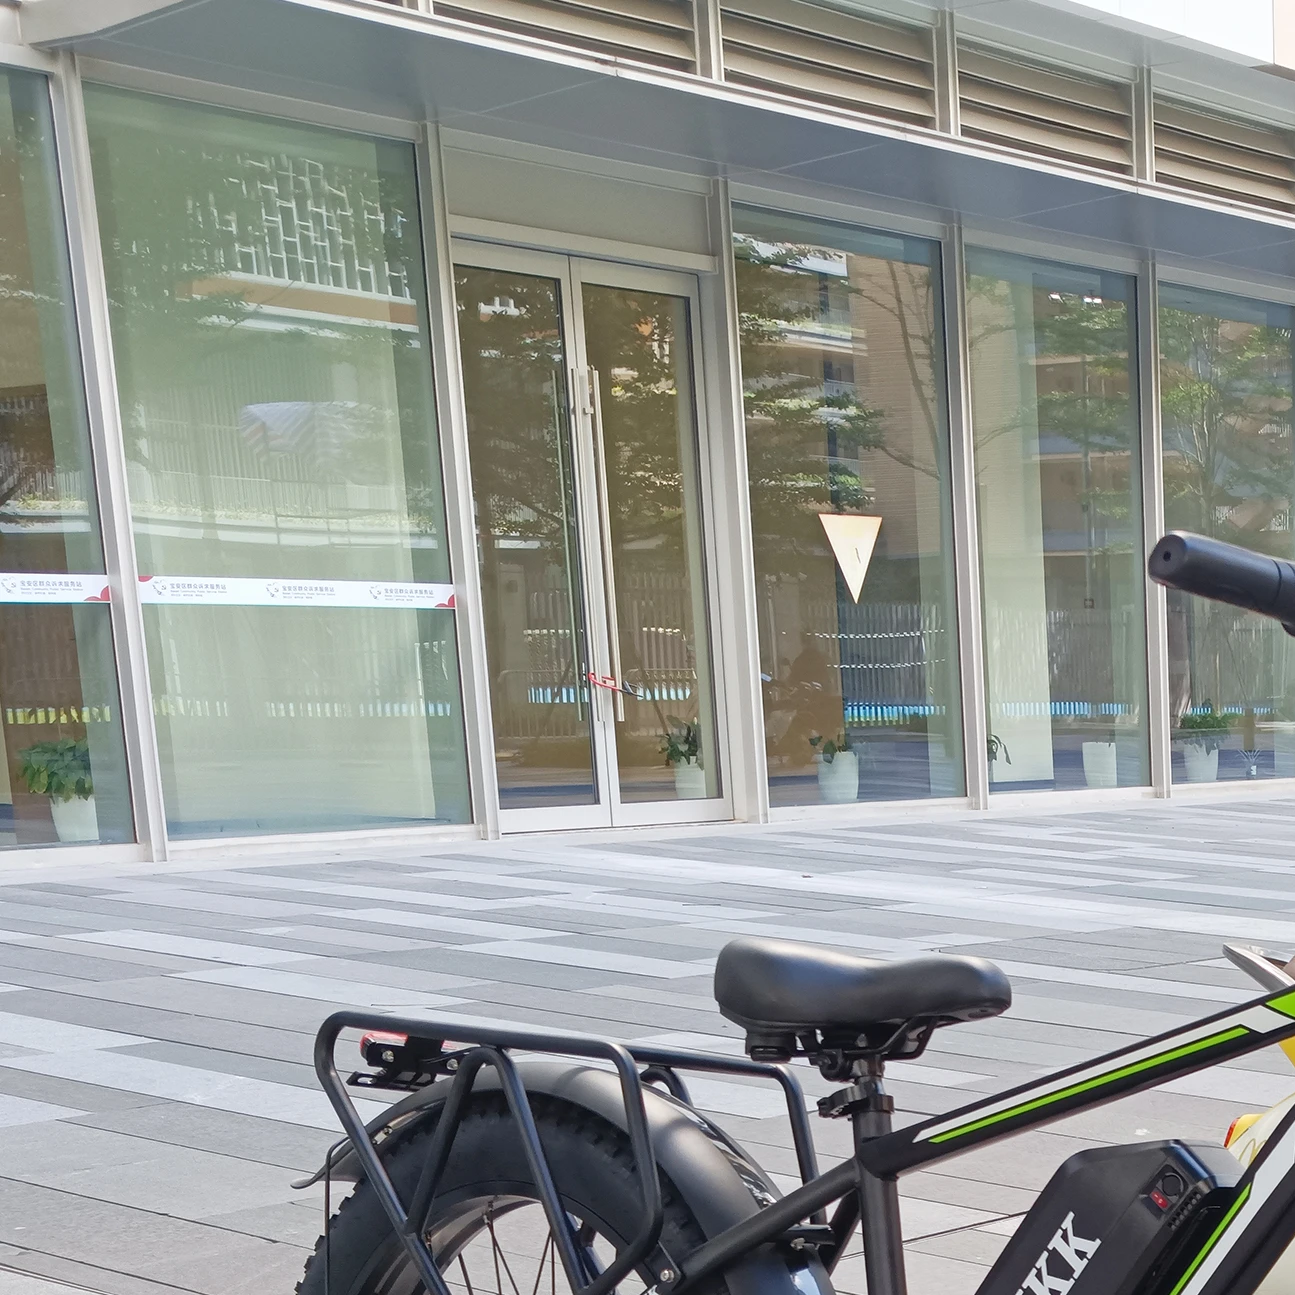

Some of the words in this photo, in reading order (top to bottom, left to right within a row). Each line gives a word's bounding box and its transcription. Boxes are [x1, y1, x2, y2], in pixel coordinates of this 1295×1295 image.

[20, 580, 83, 588] 宝安区群众诉求服务站
[169, 582, 227, 590] 宝安区群众诉求服务站
